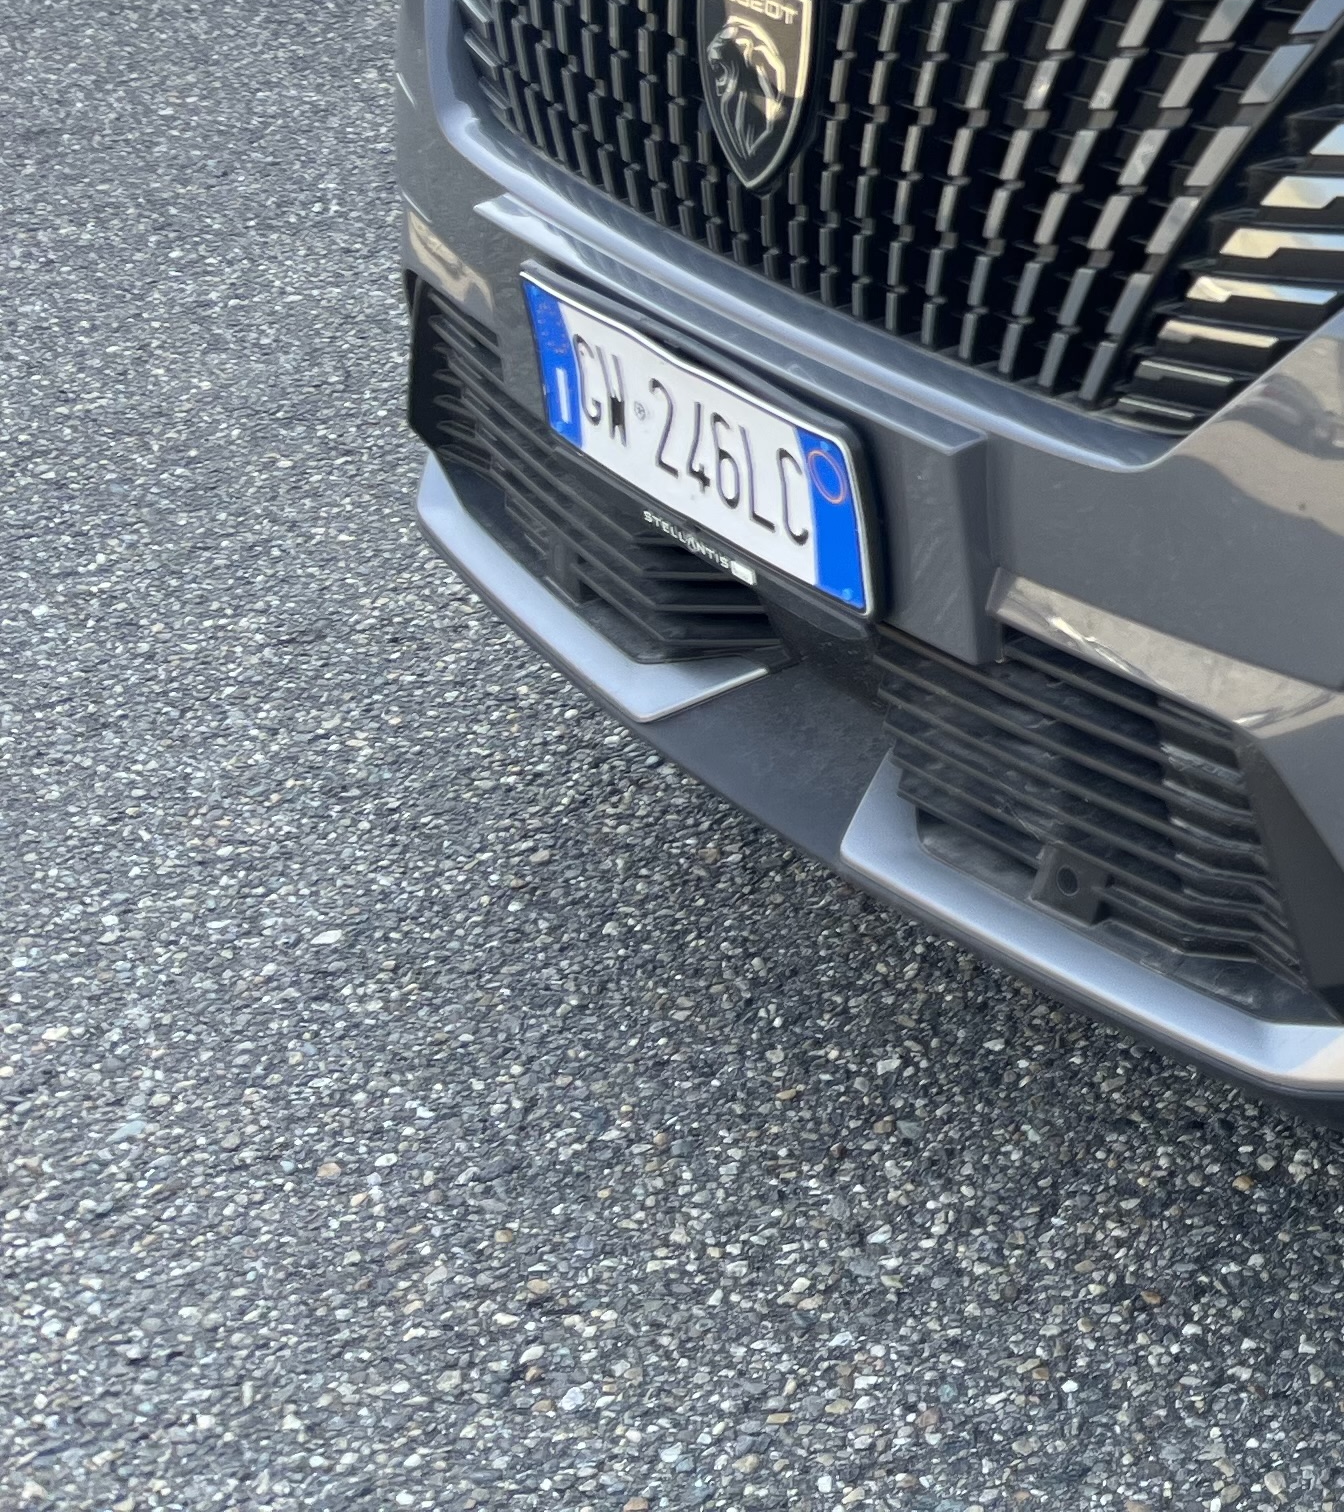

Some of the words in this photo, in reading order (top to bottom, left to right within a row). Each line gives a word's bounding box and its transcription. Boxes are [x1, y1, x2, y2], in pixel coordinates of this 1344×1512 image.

[573, 334, 627, 447] GW
[650, 378, 809, 546] 246LC
[643, 510, 730, 569] STELLANTIS
